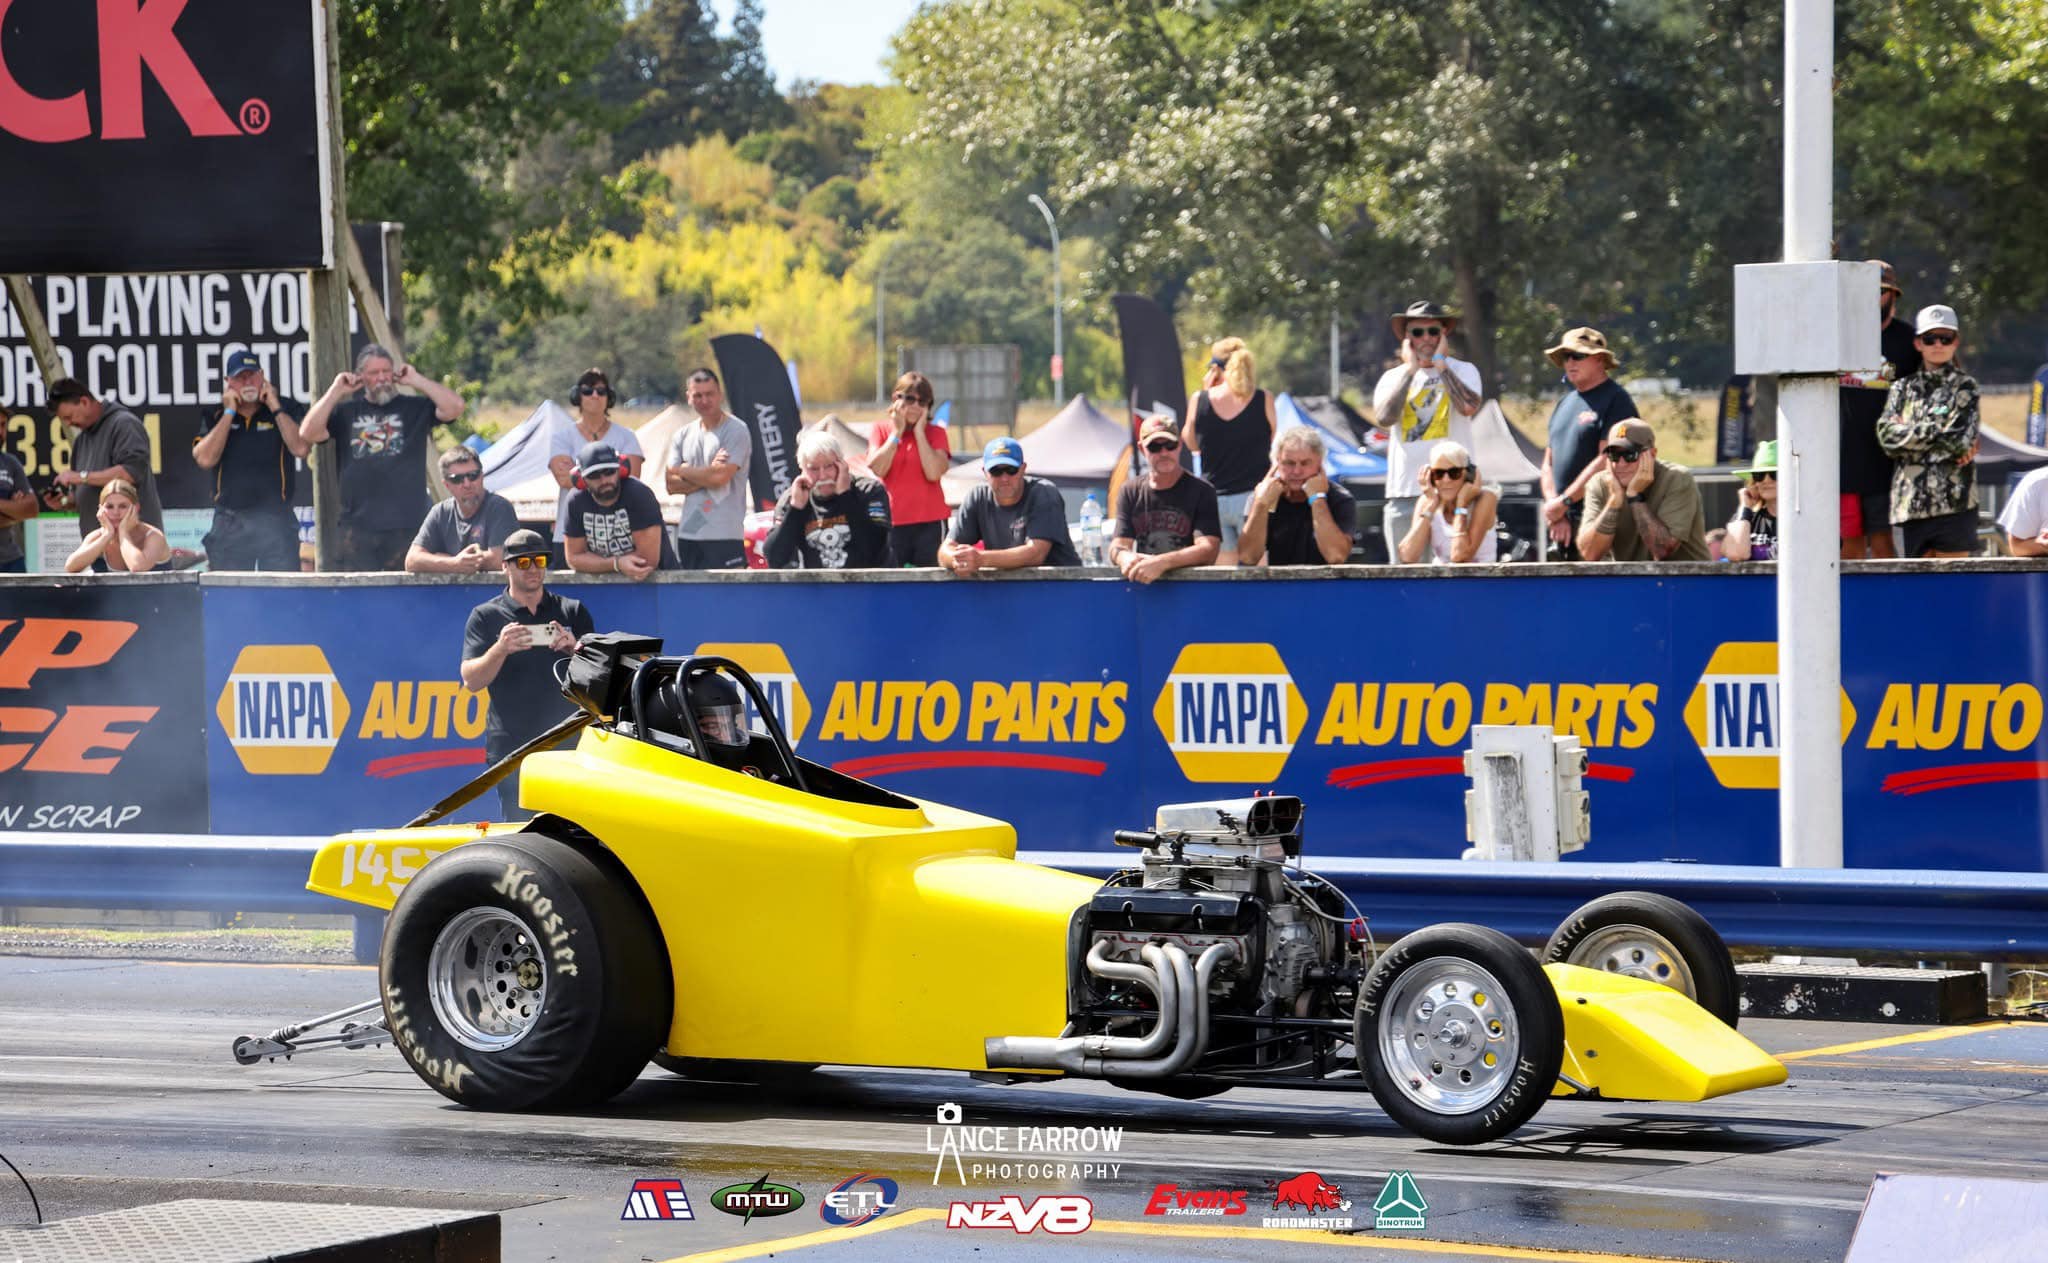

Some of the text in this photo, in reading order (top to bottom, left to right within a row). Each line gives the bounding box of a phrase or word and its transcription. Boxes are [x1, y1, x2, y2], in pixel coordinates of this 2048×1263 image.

[47, 274, 232, 337] PLAYING
[241, 272, 358, 335] YO
[754, 402, 794, 500] BATTERY
[238, 681, 329, 739] NAPA
[357, 681, 489, 739] AUTO
[818, 679, 1128, 743] AUTO PARTS
[1180, 682, 1284, 745] NAPA
[1314, 682, 1658, 749] AUTO PARTS
[1714, 682, 1780, 748] NA
[1866, 682, 2043, 752] AUTO
[28, 805, 142, 829] SCRAP
[341, 843, 443, 897] 145
